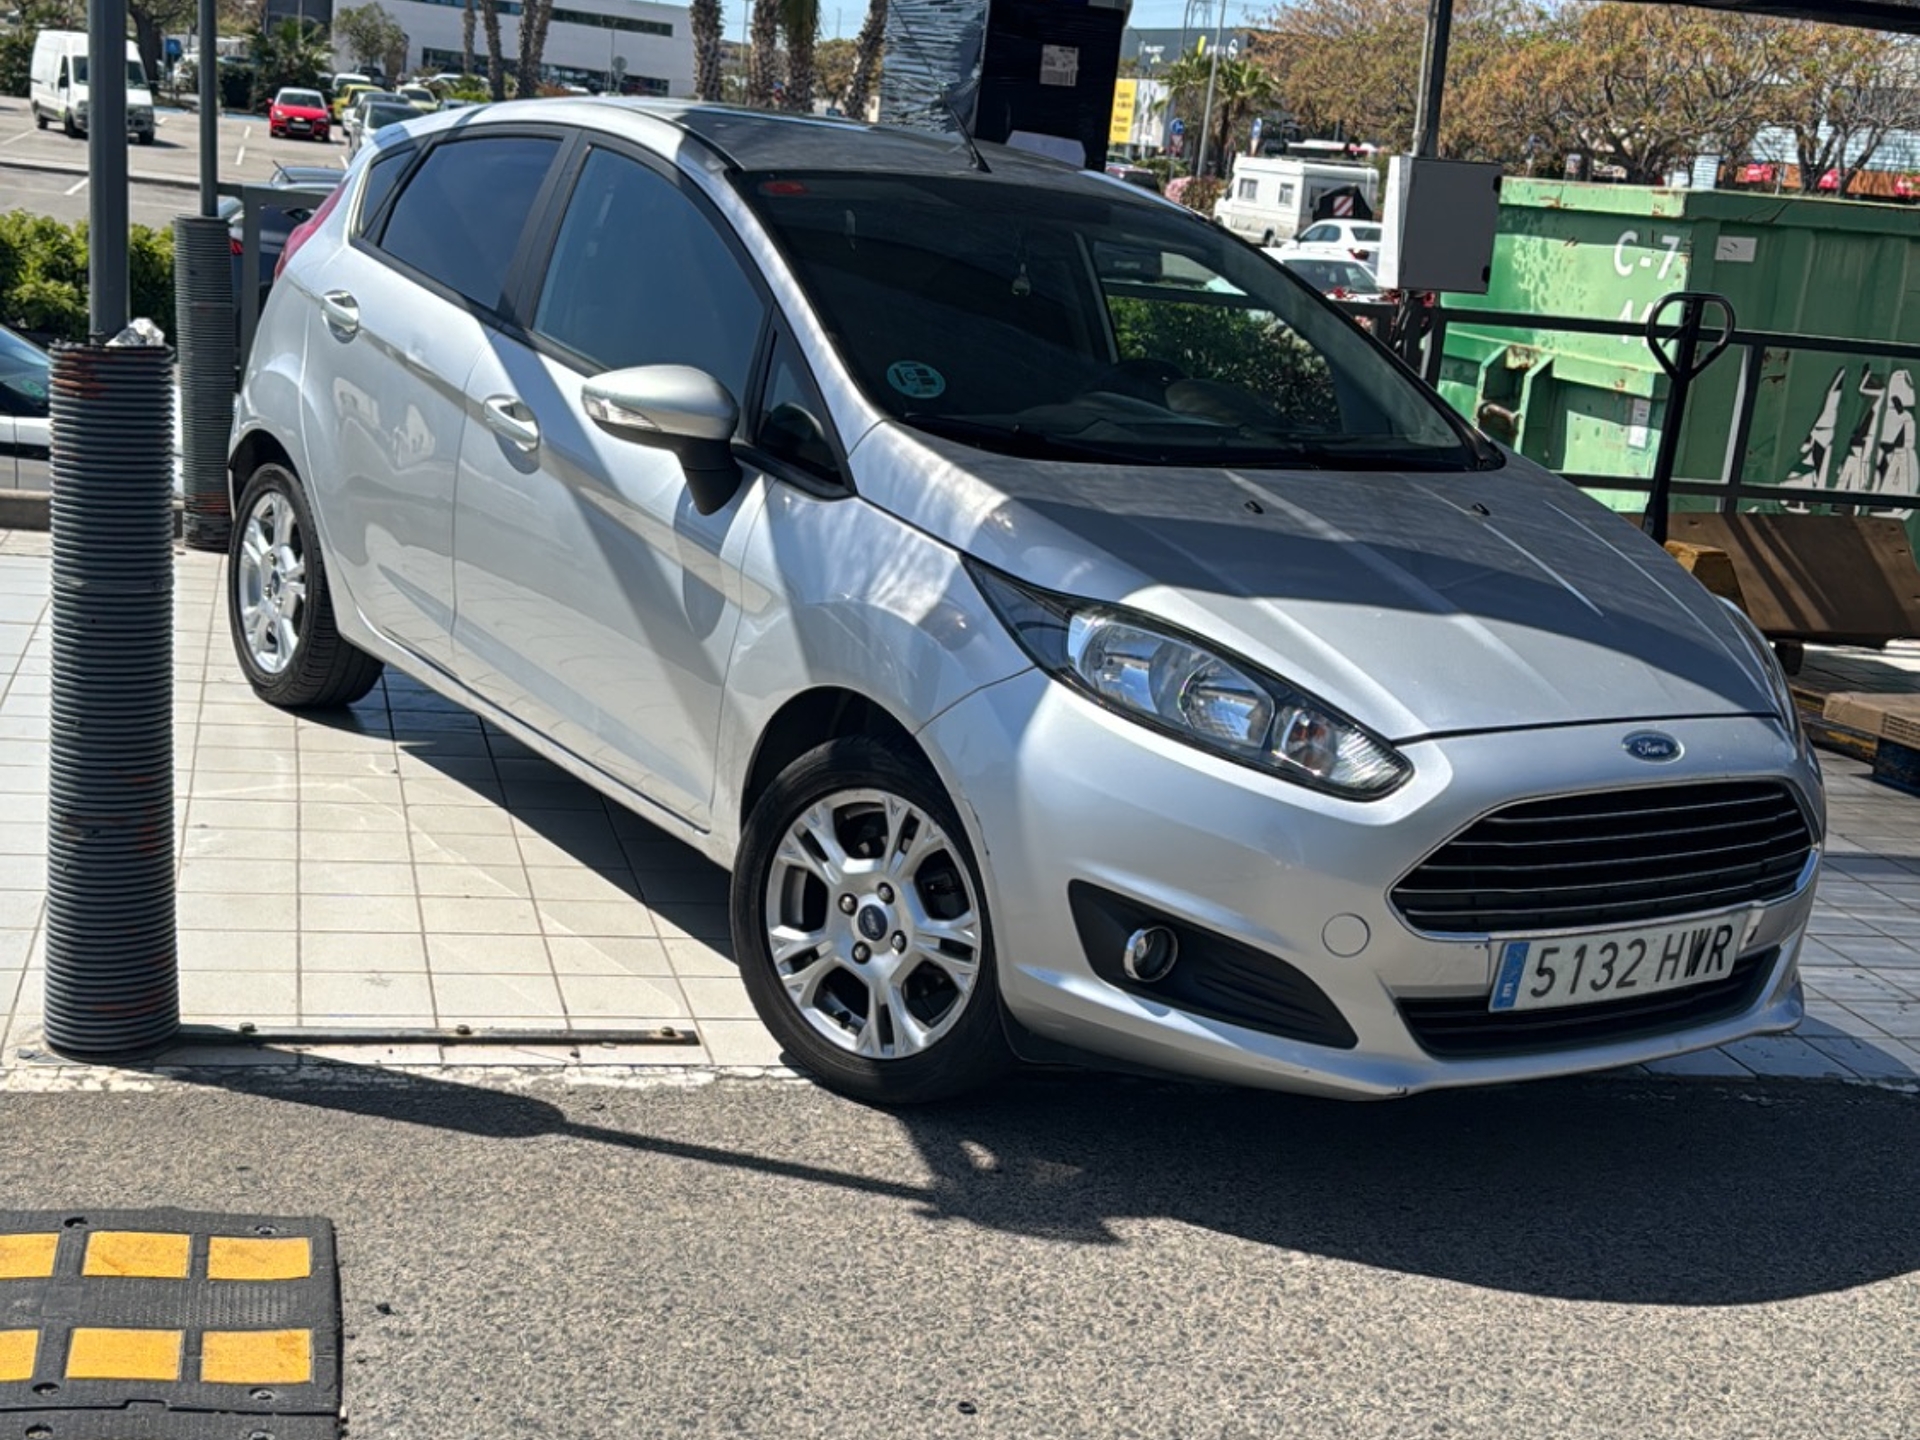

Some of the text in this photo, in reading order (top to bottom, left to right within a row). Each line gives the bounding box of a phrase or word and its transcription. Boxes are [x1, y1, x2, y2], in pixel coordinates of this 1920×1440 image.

[1614, 230, 1681, 280] C-7
[1637, 740, 1670, 756] Ford
[1530, 938, 1648, 998] 5132
[1654, 924, 1734, 983] HWR
